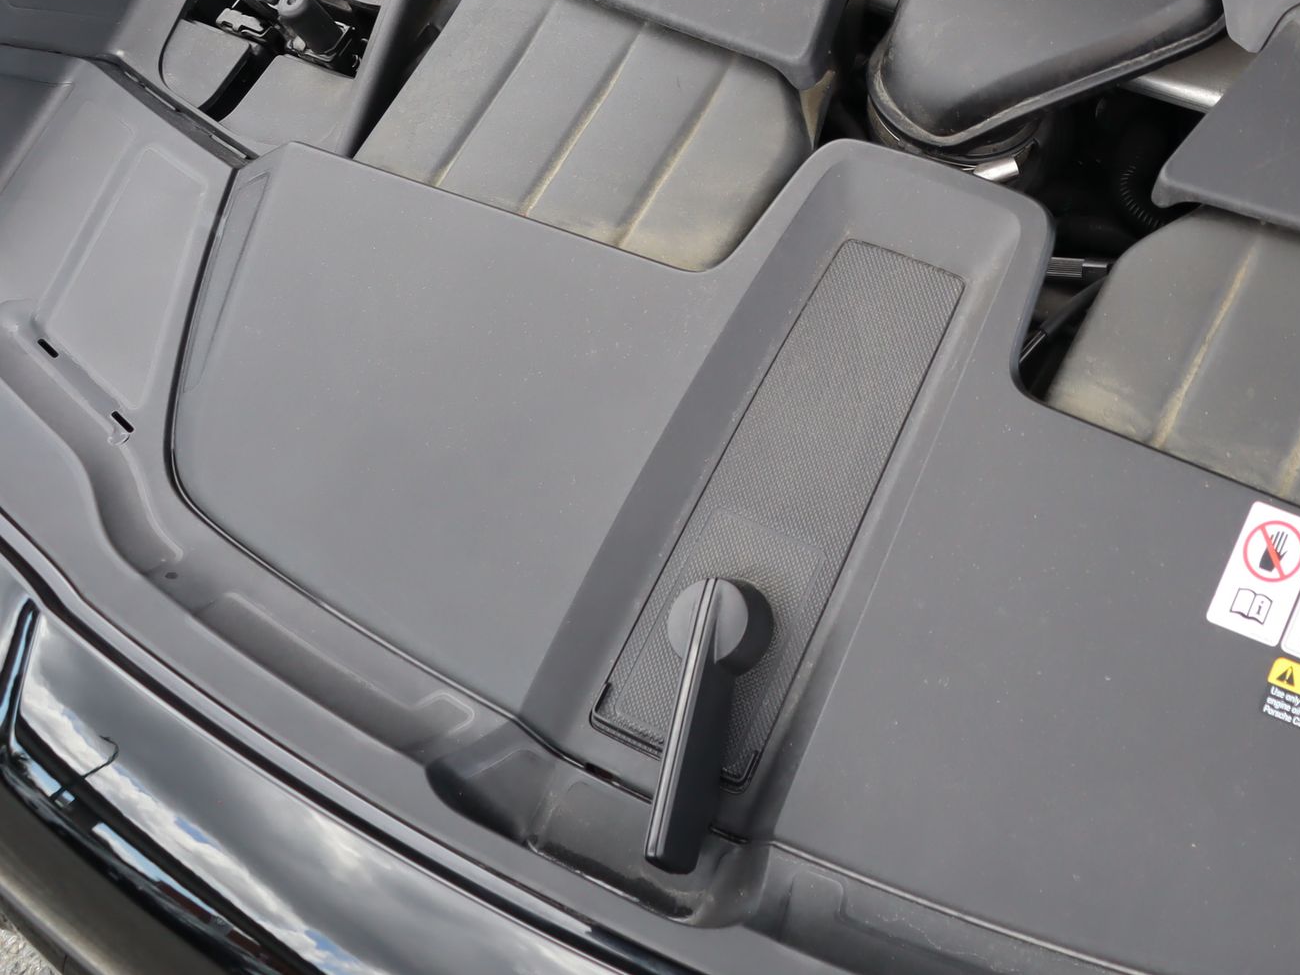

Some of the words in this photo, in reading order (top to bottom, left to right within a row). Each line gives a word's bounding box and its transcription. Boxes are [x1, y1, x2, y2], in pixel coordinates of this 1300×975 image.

[1270, 686, 1285, 698] Use
[1266, 697, 1291, 712] engine
[1263, 704, 1292, 723] Porsche
